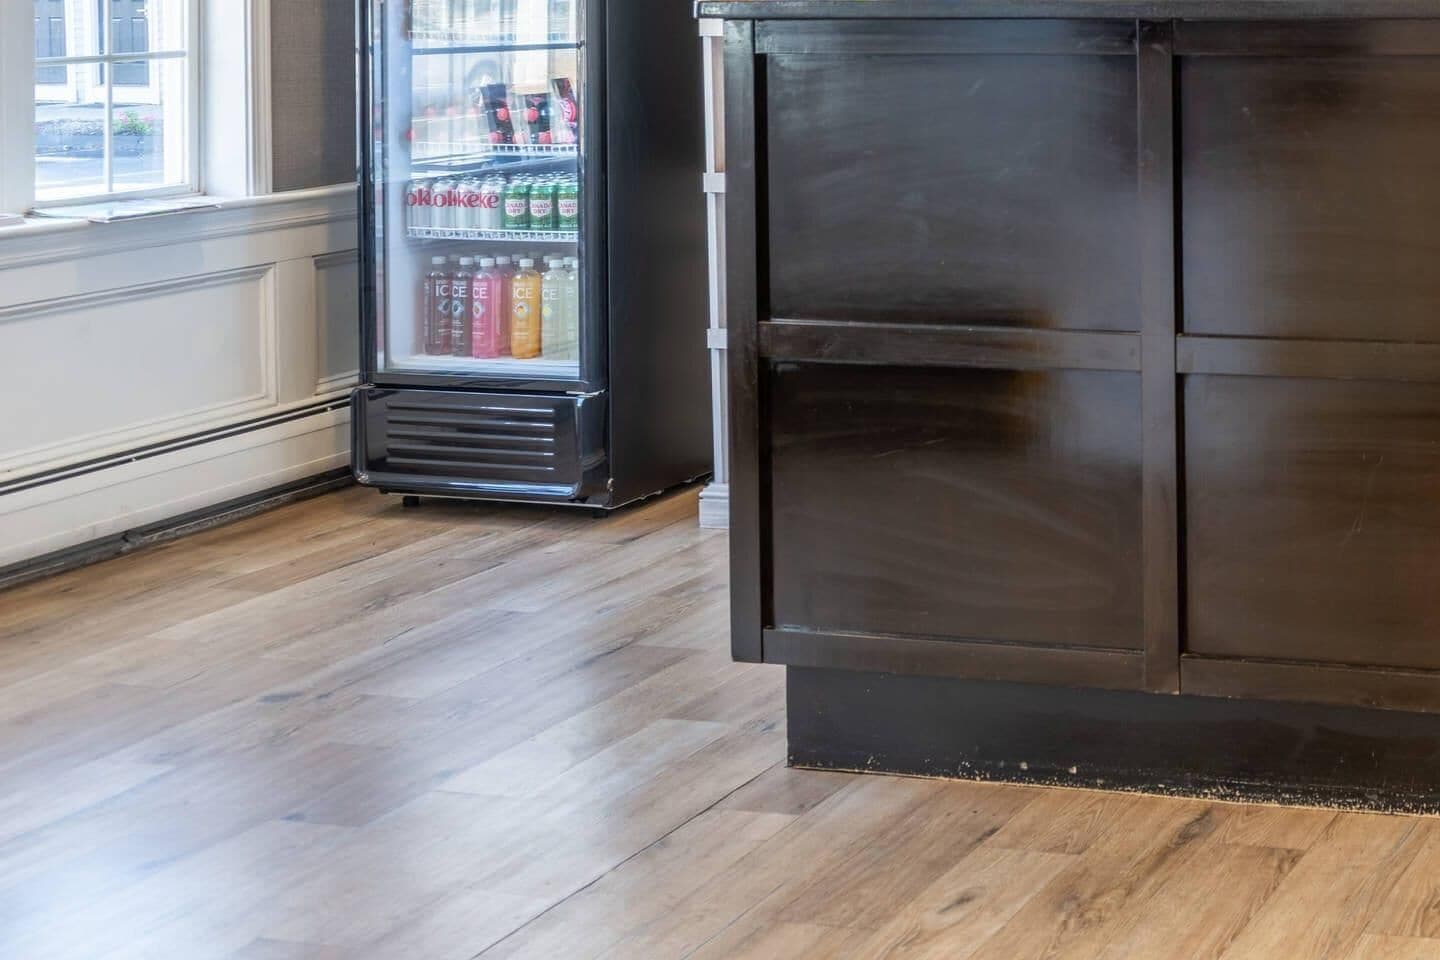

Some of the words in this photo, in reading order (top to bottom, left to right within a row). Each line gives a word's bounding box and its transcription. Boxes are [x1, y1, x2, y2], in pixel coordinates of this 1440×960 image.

[435, 285, 449, 297] IC
[452, 286, 468, 298] CE
[472, 287, 489, 299] CE
[513, 287, 534, 299] ICE
